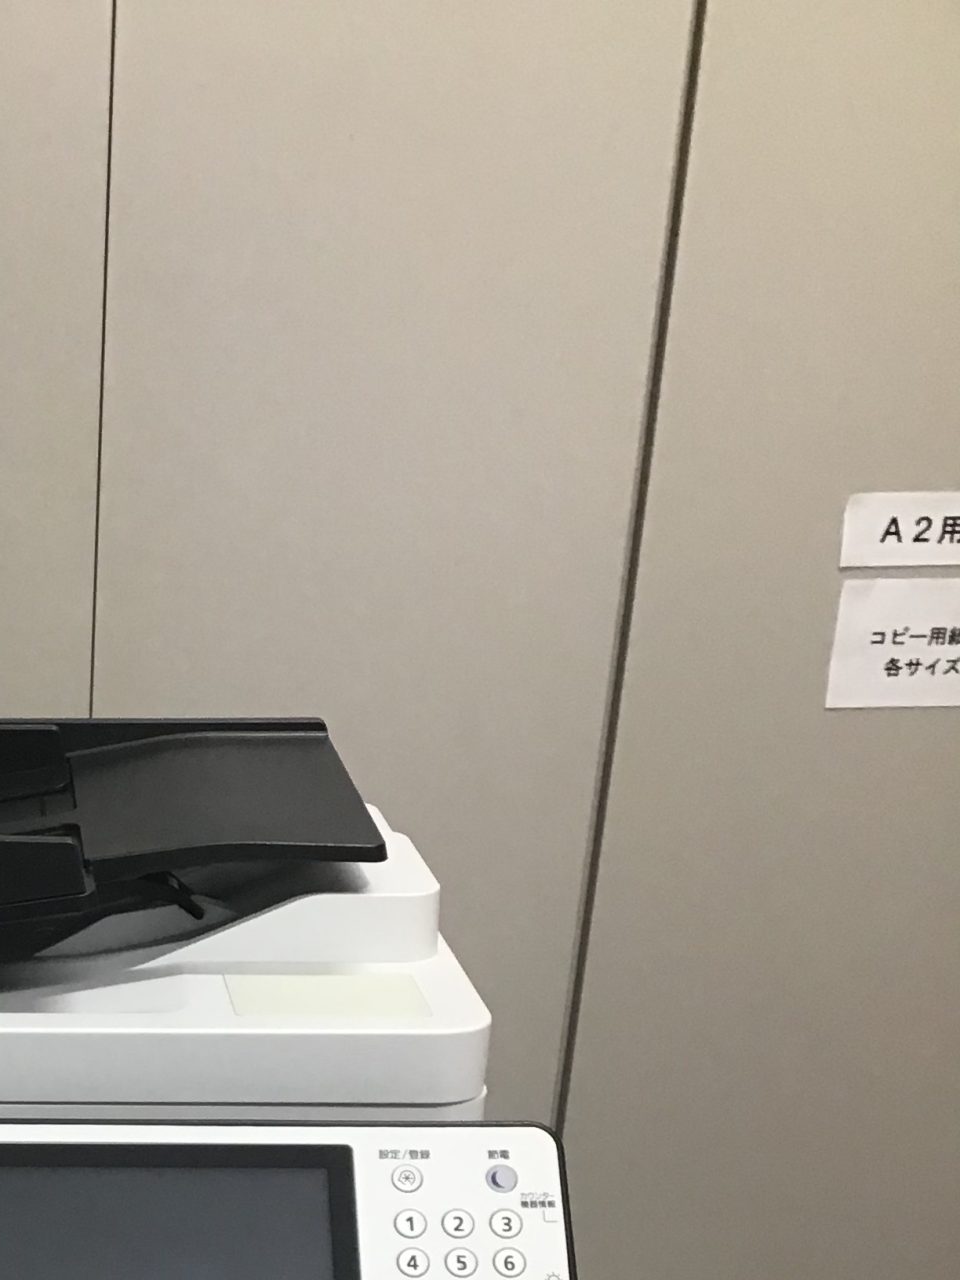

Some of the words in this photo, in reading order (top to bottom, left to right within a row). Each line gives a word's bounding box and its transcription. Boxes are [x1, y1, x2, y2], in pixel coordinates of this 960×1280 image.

[405, 1217, 415, 1232] 1
[453, 1216, 465, 1232] 2
[501, 1217, 513, 1232] 3
[406, 1255, 419, 1271] 4
[456, 1255, 467, 1271] 5
[504, 1255, 516, 1271] 6
